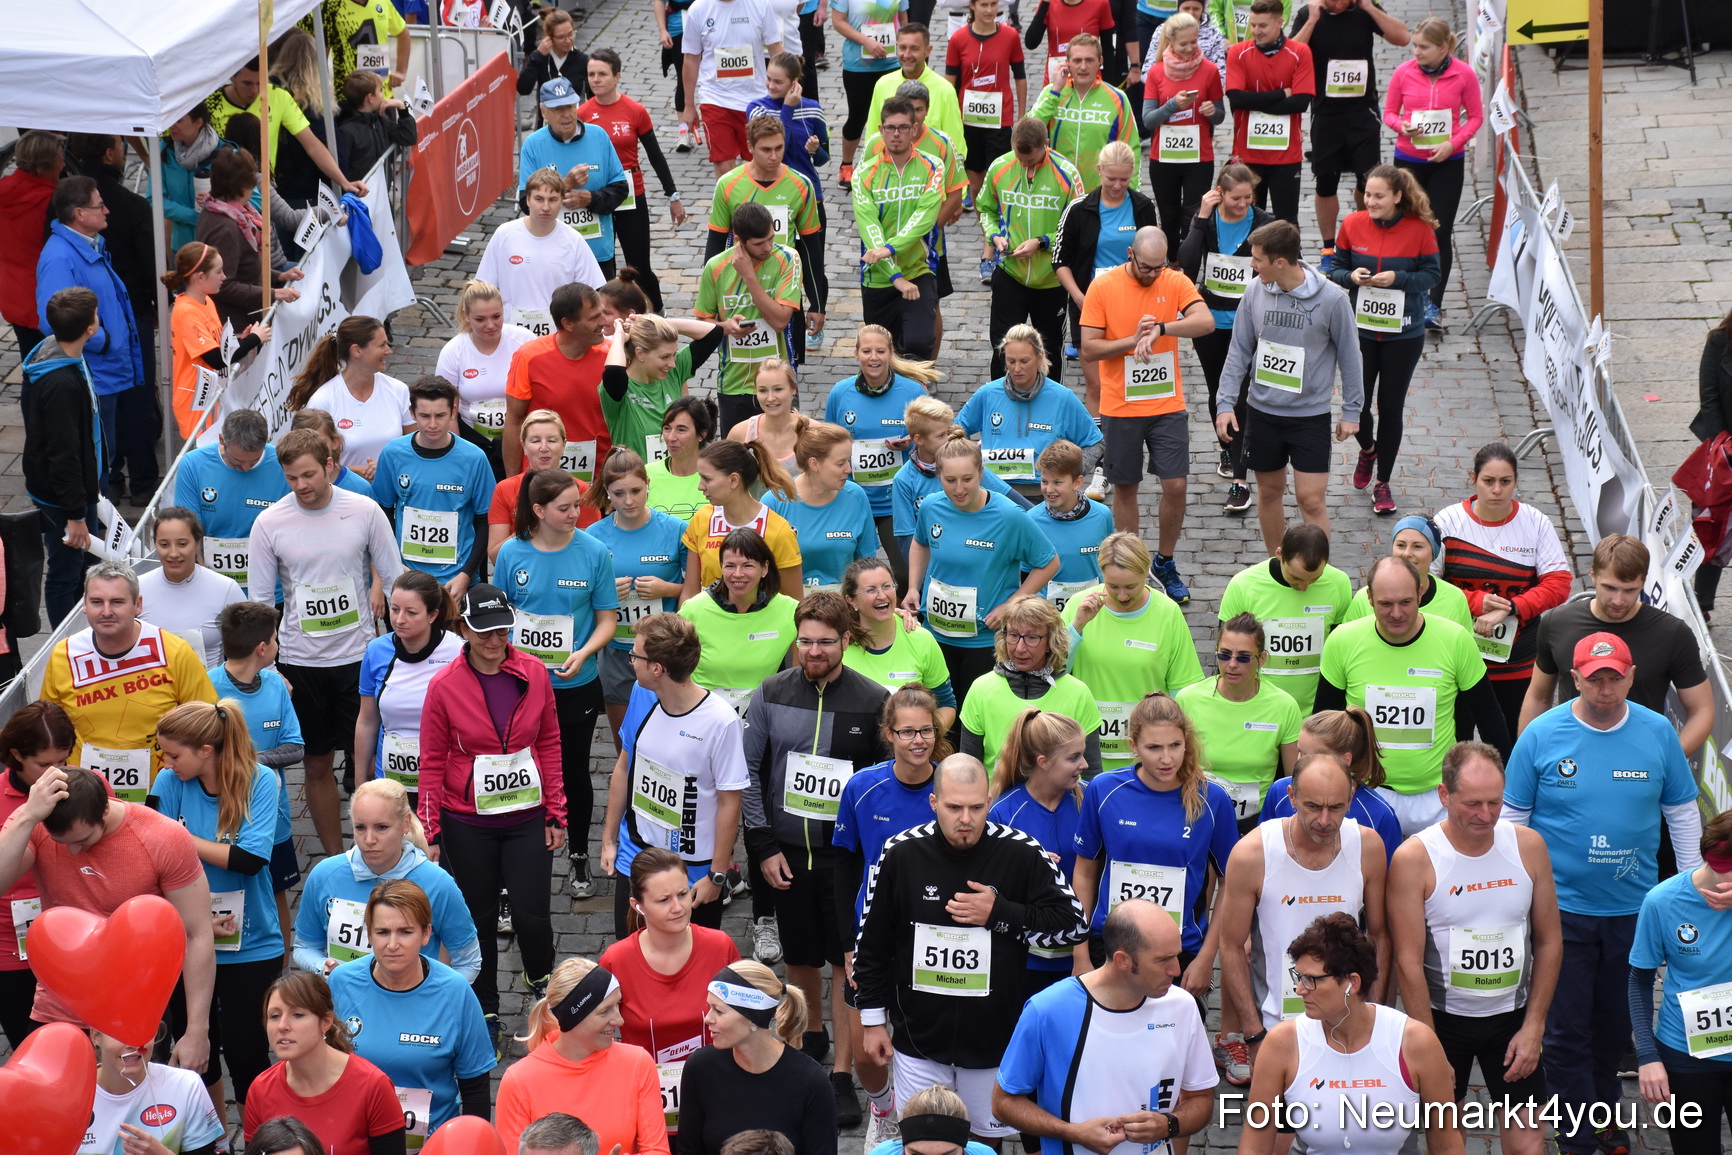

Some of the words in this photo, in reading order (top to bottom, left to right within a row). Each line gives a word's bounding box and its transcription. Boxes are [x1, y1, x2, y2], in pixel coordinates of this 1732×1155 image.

[363, 56, 385, 67] 2691
[721, 56, 748, 68] 8005
[1333, 71, 1361, 83] 5164
[968, 102, 996, 115] 5063
[1056, 106, 1111, 125] BOCK
[1254, 123, 1284, 135] 5243
[1417, 121, 1446, 135] 5272
[1165, 137, 1194, 149] 5242
[1001, 190, 1060, 209] BOCK
[563, 210, 594, 225] 5038
[1559, 211, 1569, 235] swn
[301, 222, 316, 245] swn
[1212, 266, 1245, 282] 5084
[1363, 300, 1396, 316] 5098
[1263, 354, 1297, 374] 5227
[1132, 367, 1168, 384] 5226
[199, 382, 210, 406] swn
[559, 455, 588, 470] 214
[859, 452, 895, 470] 5203
[868, 471, 890, 480] Stefanie
[436, 483, 464, 492] BOCK
[1655, 505, 1670, 534] swn
[112, 521, 124, 551] swn
[410, 524, 449, 543] 5128
[965, 539, 994, 548] BOCK
[421, 547, 434, 555] Paul
[1675, 542, 1696, 572] swn
[557, 579, 588, 588] BOCK
[305, 594, 349, 617] 5016
[932, 597, 968, 619] 5037
[320, 618, 341, 627] Marcel
[520, 629, 563, 648] 5085
[1269, 635, 1313, 653] 5061
[1285, 658, 1300, 666] Fred
[76, 685, 119, 708] MAX
[122, 673, 174, 695] BÖGL
[1375, 705, 1425, 725] 5210
[1099, 718, 1130, 737] 041
[388, 753, 420, 773] 506
[484, 768, 531, 792] 5026
[1613, 770, 1649, 778] BOCK
[641, 775, 677, 808] 5108
[793, 772, 841, 798] 5010
[500, 793, 518, 802] Vroni
[803, 799, 825, 809] Daniel
[649, 802, 665, 816] Lukas
[680, 776, 698, 856] HUBER
[1182, 826, 1192, 838] 2
[1590, 835, 1610, 848] 18.
[1588, 848, 1633, 856] Neumarkter
[1588, 856, 1624, 864] Stadtlauf
[1467, 878, 1518, 892] KLEBL
[1120, 882, 1174, 907] 5237
[1298, 895, 1346, 904] KLEBL
[925, 946, 979, 970] 5163
[1461, 947, 1515, 971] 5013
[936, 974, 966, 985] Michael
[1475, 976, 1502, 986] Roland
[730, 990, 764, 1001] CHIEMGAU
[400, 1033, 441, 1045] BOCK
[1706, 1033, 1732, 1044] Magda
[670, 1044, 690, 1056] DEHN
[1329, 1079, 1387, 1088] KLEBL
